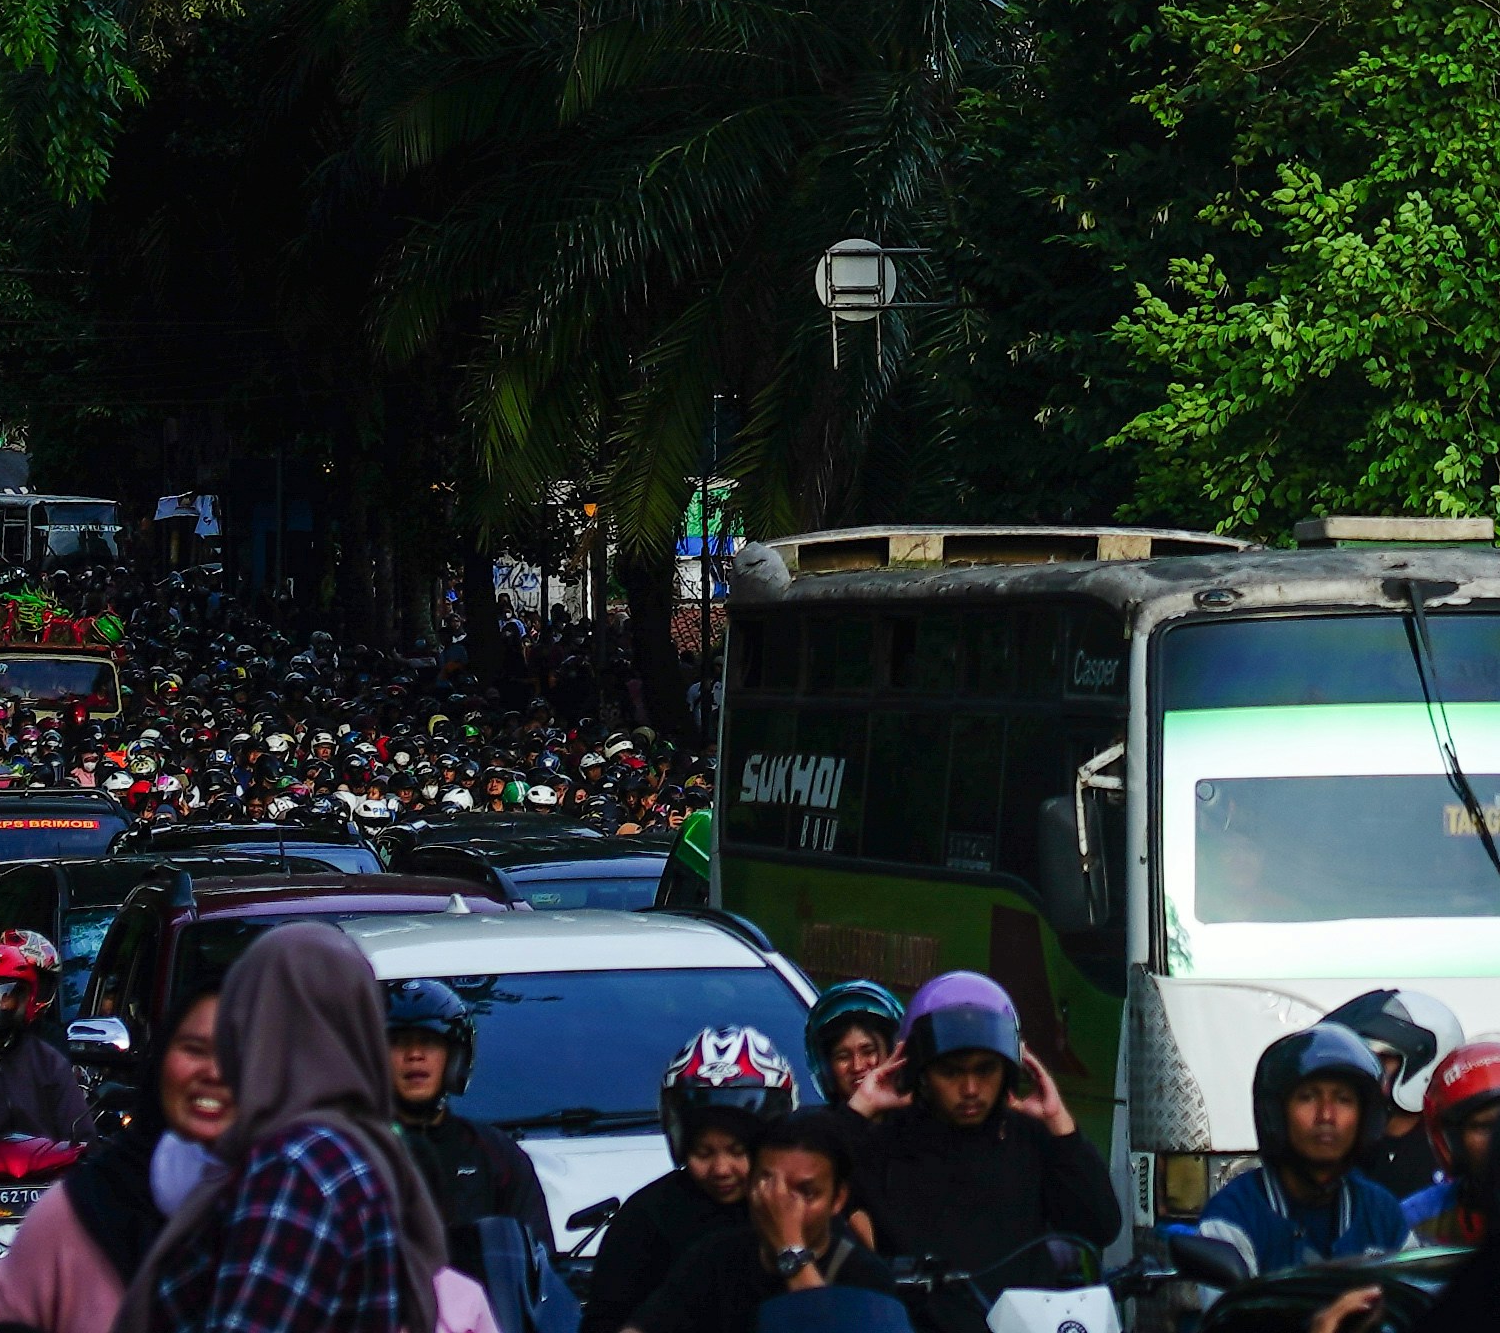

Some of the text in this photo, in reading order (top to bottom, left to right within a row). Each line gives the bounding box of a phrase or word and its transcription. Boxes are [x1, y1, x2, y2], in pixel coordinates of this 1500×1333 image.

[1073, 649, 1120, 690] Casper
[740, 754, 846, 809] SUKHOI
[29, 819, 95, 829] BRIMOB
[0, 1190, 40, 1203] 6270
